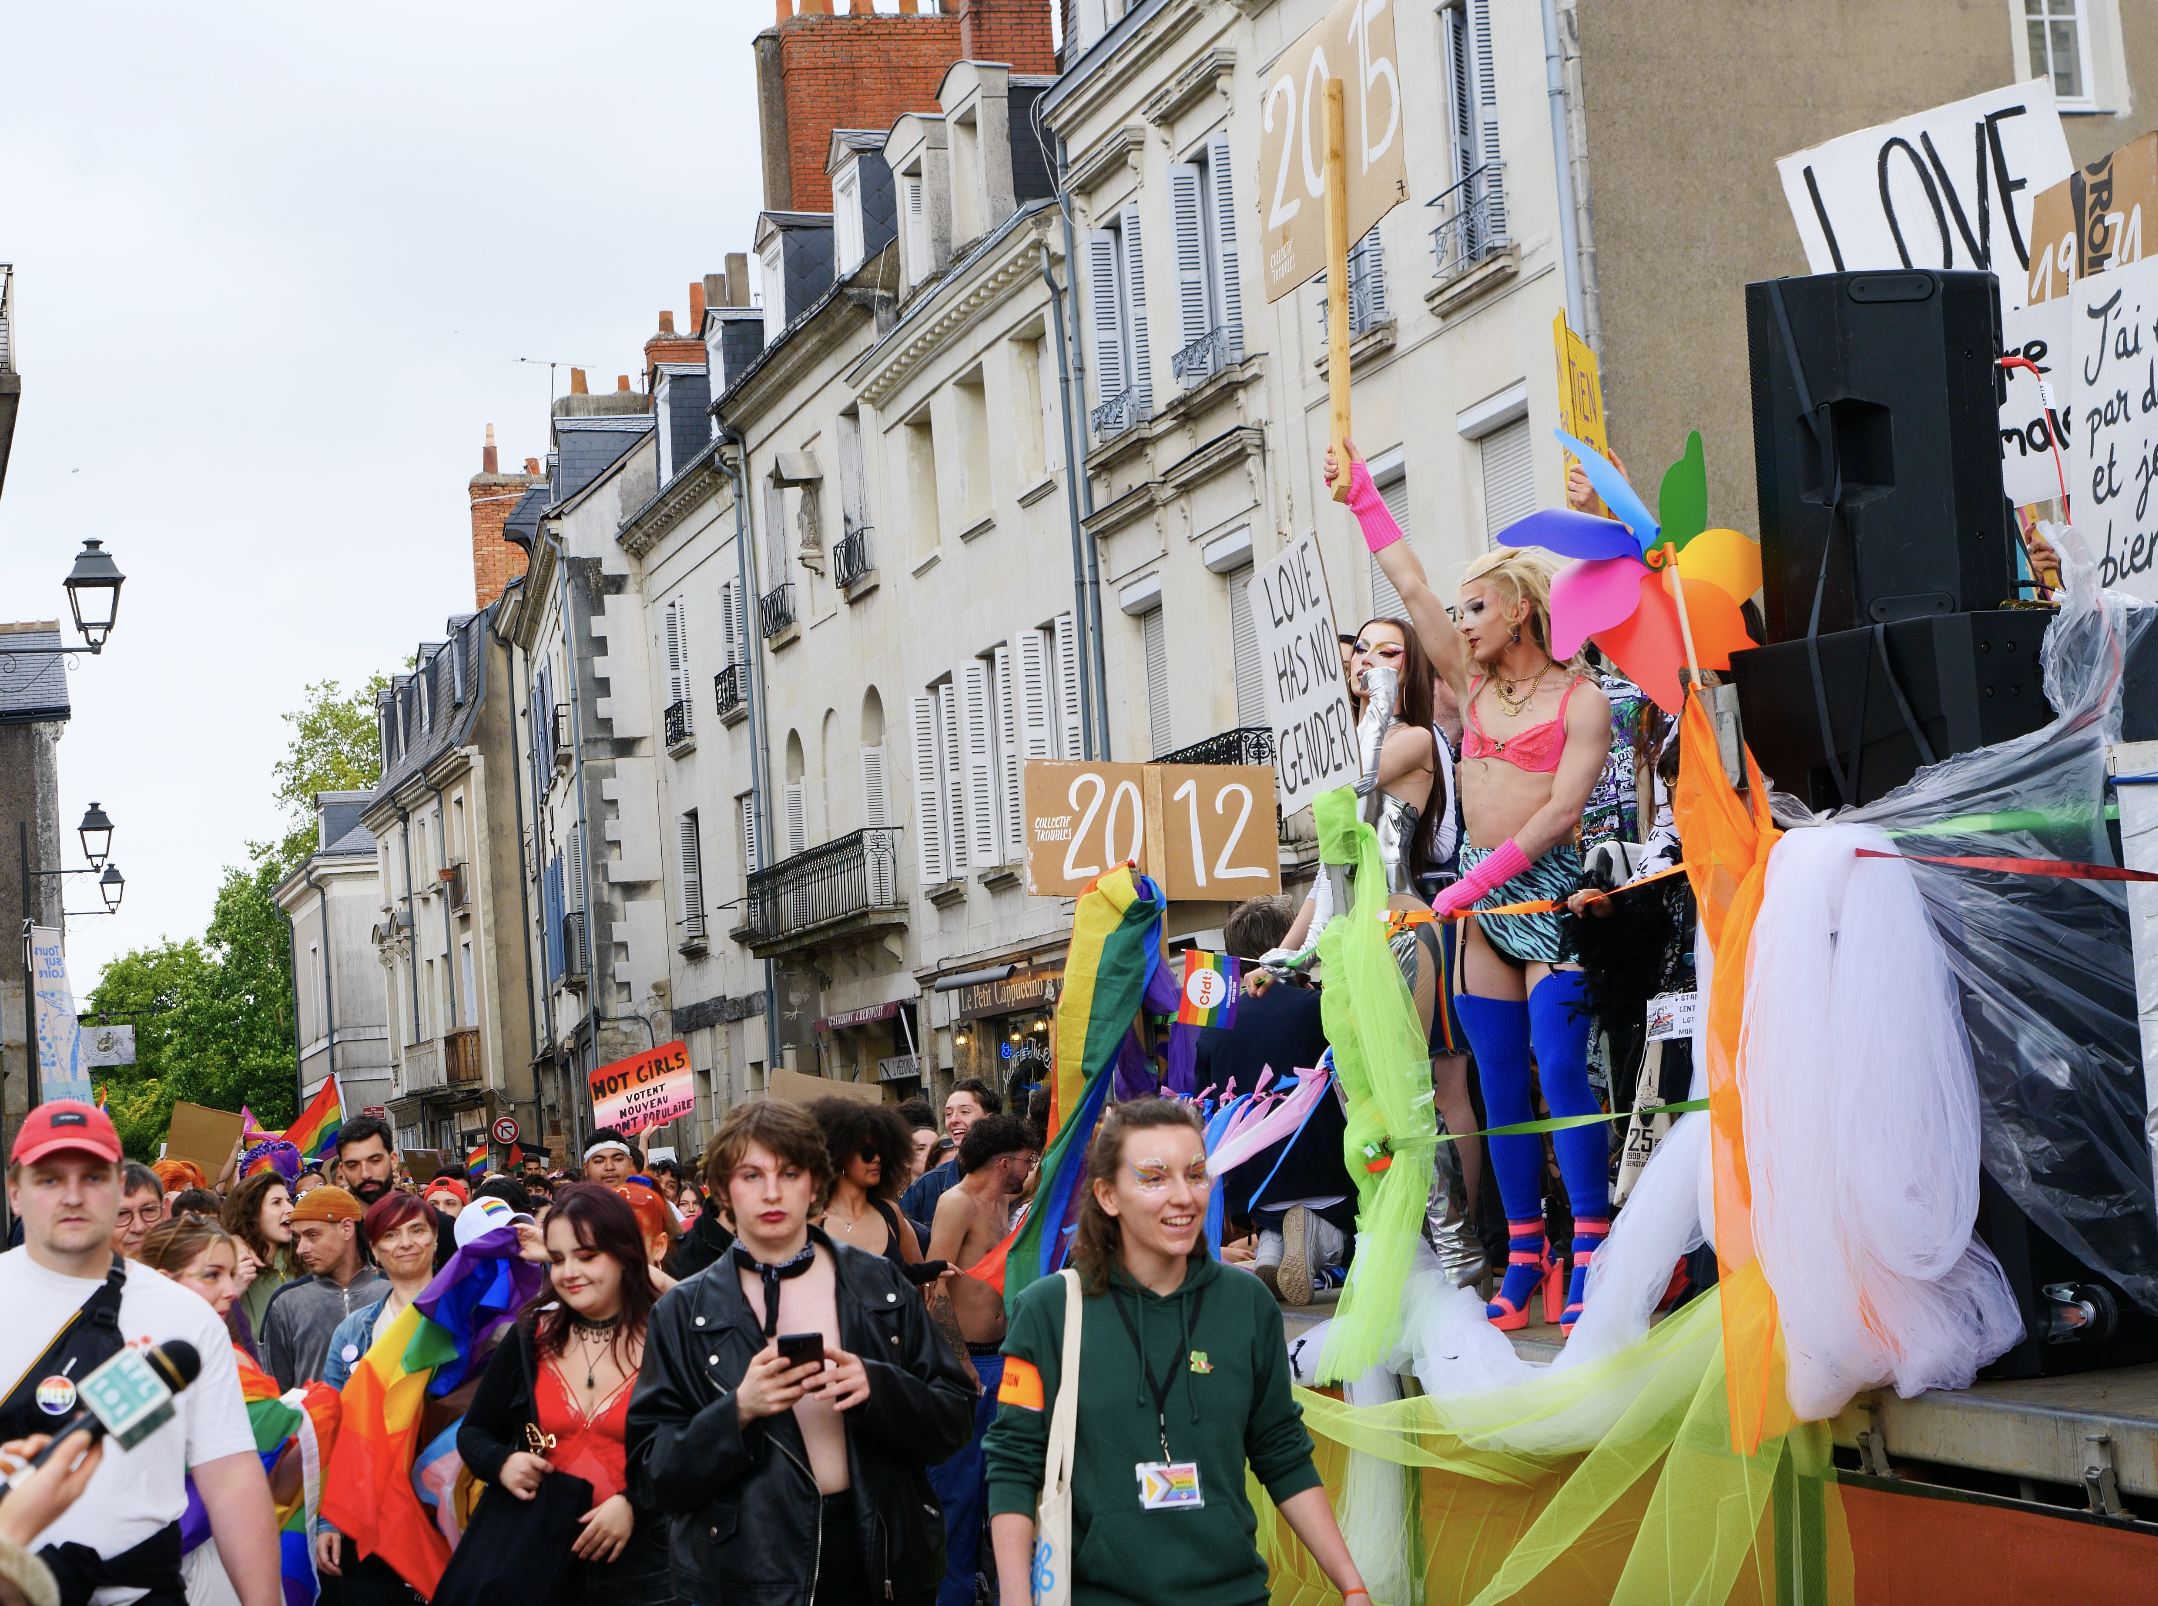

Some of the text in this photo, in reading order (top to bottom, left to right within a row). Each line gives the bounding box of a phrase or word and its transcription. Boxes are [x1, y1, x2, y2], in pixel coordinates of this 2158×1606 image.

[1264, 0, 1400, 231] 2015
[2084, 288, 2143, 386] J'ai
[2086, 389, 2132, 460] par
[2092, 442, 2123, 505] et
[1263, 541, 1320, 629] LOVE
[1273, 616, 1337, 704] HAS NO
[1279, 697, 1355, 795] GENDER
[1063, 773, 1271, 887] 2012
[961, 987, 972, 1012] Le
[973, 983, 993, 1009] Petit
[994, 978, 1043, 1008] Cappuccino
[592, 1071, 630, 1101] HOT
[619, 1095, 668, 1119] NOUVEAU
[626, 1083, 666, 1103] VOTENT
[1626, 1151, 1641, 1160] 1999
[1627, 1127, 1654, 1153] 25
[1002, 1372, 1021, 1388] TION
